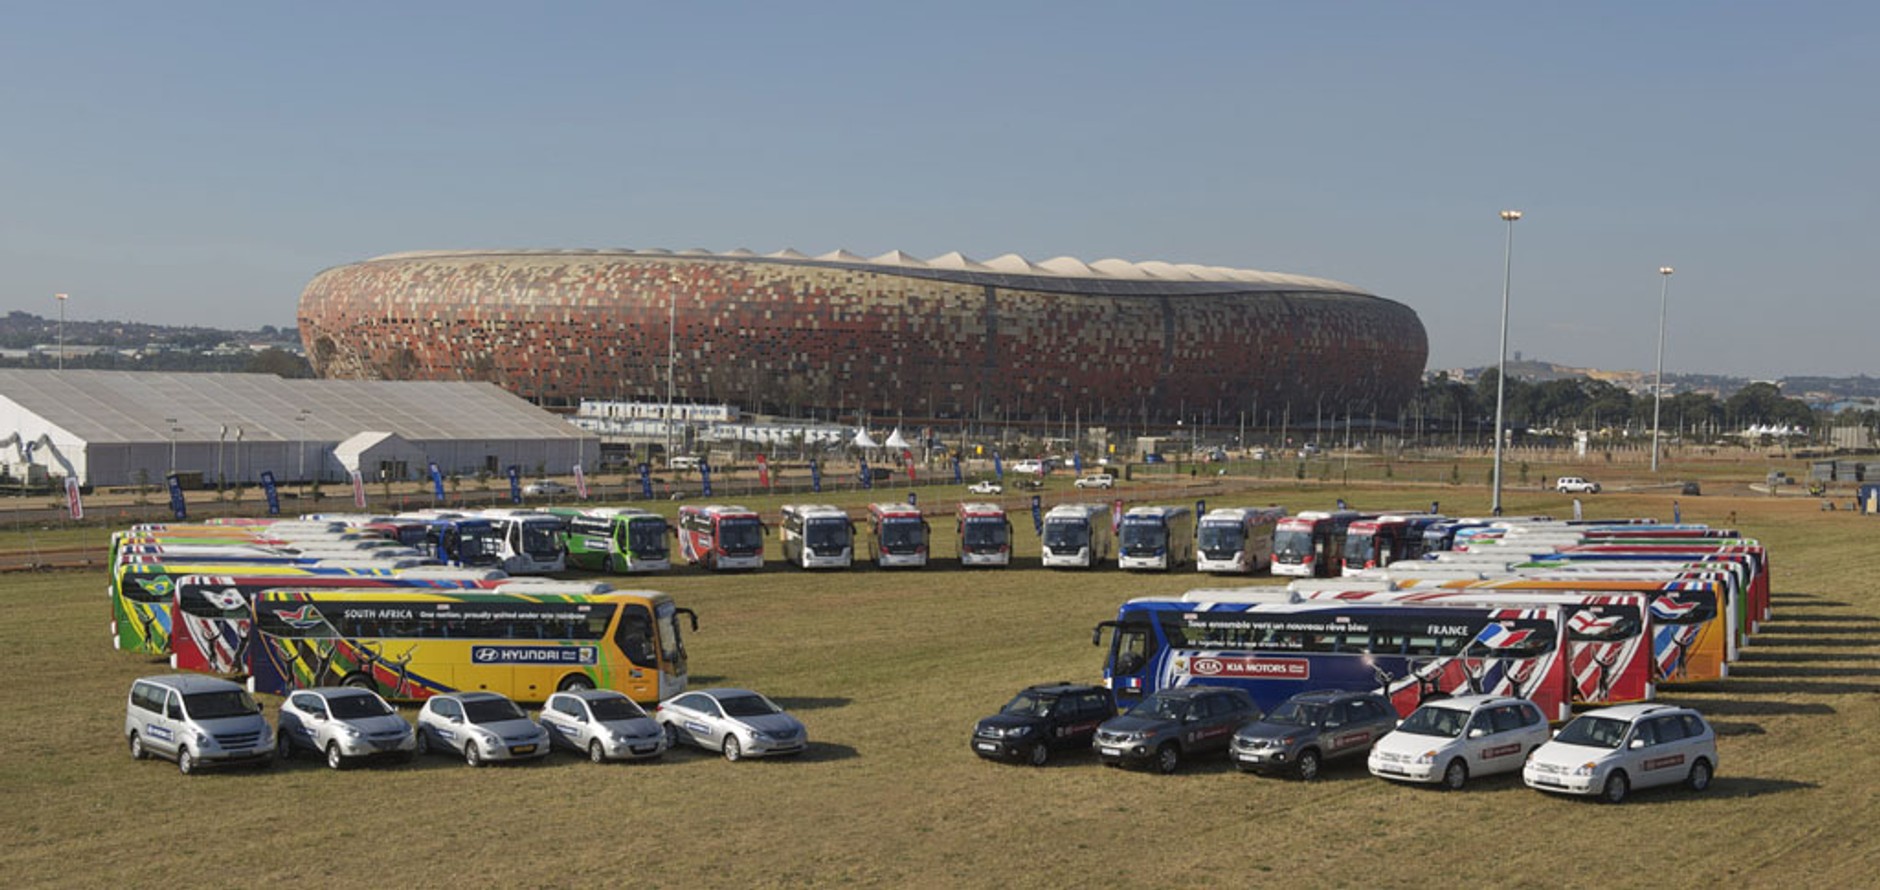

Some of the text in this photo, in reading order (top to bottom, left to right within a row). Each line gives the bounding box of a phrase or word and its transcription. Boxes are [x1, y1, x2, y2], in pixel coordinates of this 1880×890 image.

[344, 609, 376, 618] SOUTH
[379, 609, 413, 618] AFRICA
[1428, 624, 1468, 636] FRANCE
[502, 650, 559, 660] HYUNDAI
[1199, 661, 1219, 670] KIA
[1226, 663, 1244, 672] KIA
[1245, 663, 1287, 673] MOTORS
